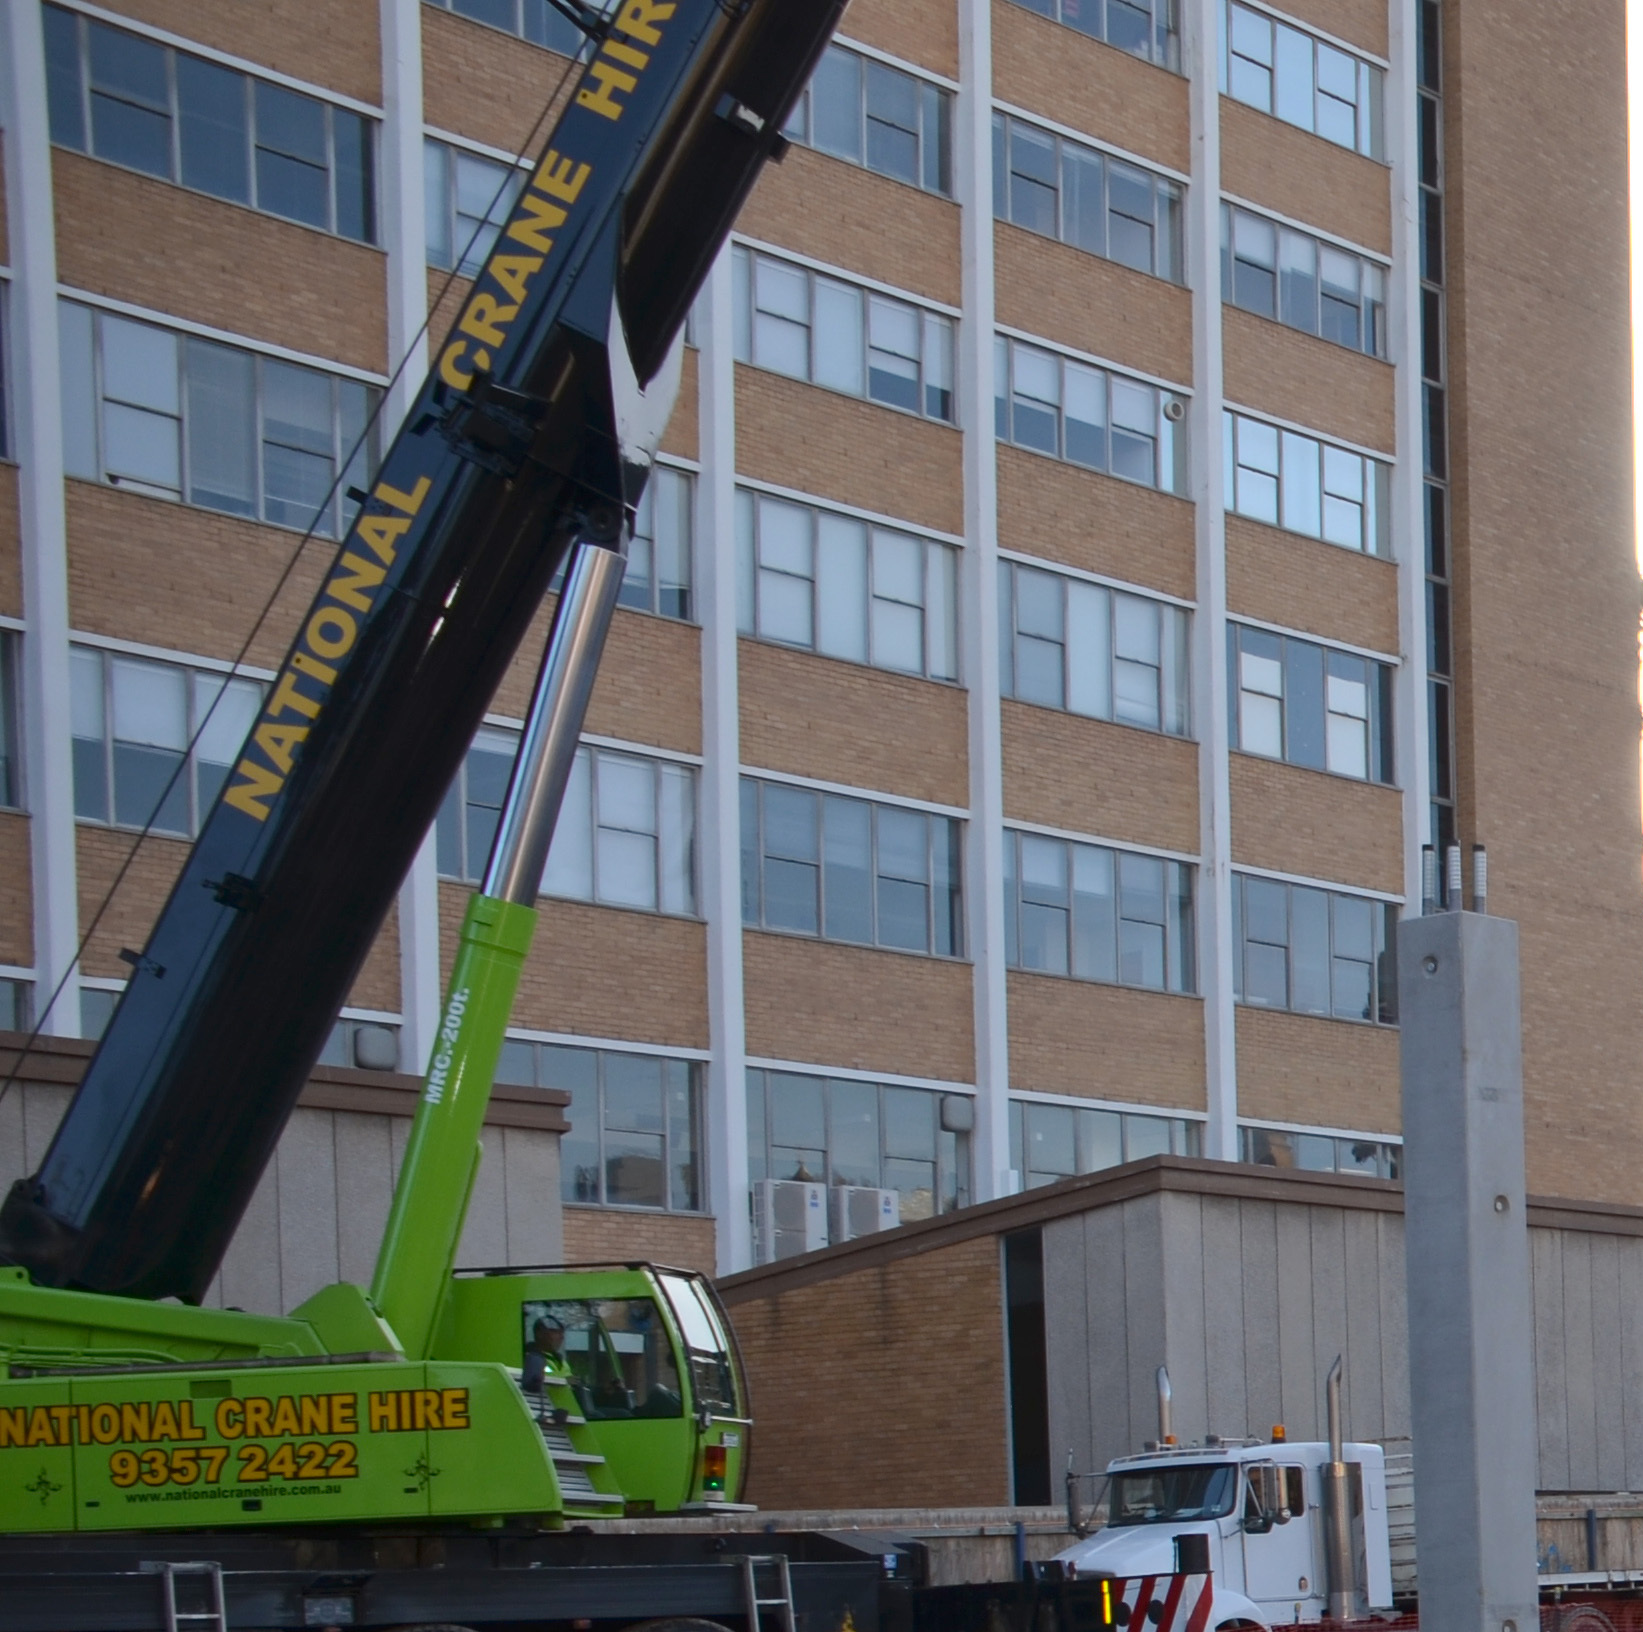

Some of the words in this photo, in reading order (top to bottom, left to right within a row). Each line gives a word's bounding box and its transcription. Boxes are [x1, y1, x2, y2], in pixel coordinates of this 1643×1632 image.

[223, 475, 432, 822] NATIONAL
[440, 149, 592, 392] CRANE
[0, 1400, 206, 1448] NATIONAL
[215, 1392, 359, 1440] CRANE
[368, 1387, 470, 1433] HIRE
[109, 1447, 231, 1488] 9357
[237, 1440, 359, 1482] 2422
[125, 1483, 342, 1503] www.nationalcranehire.com.au
